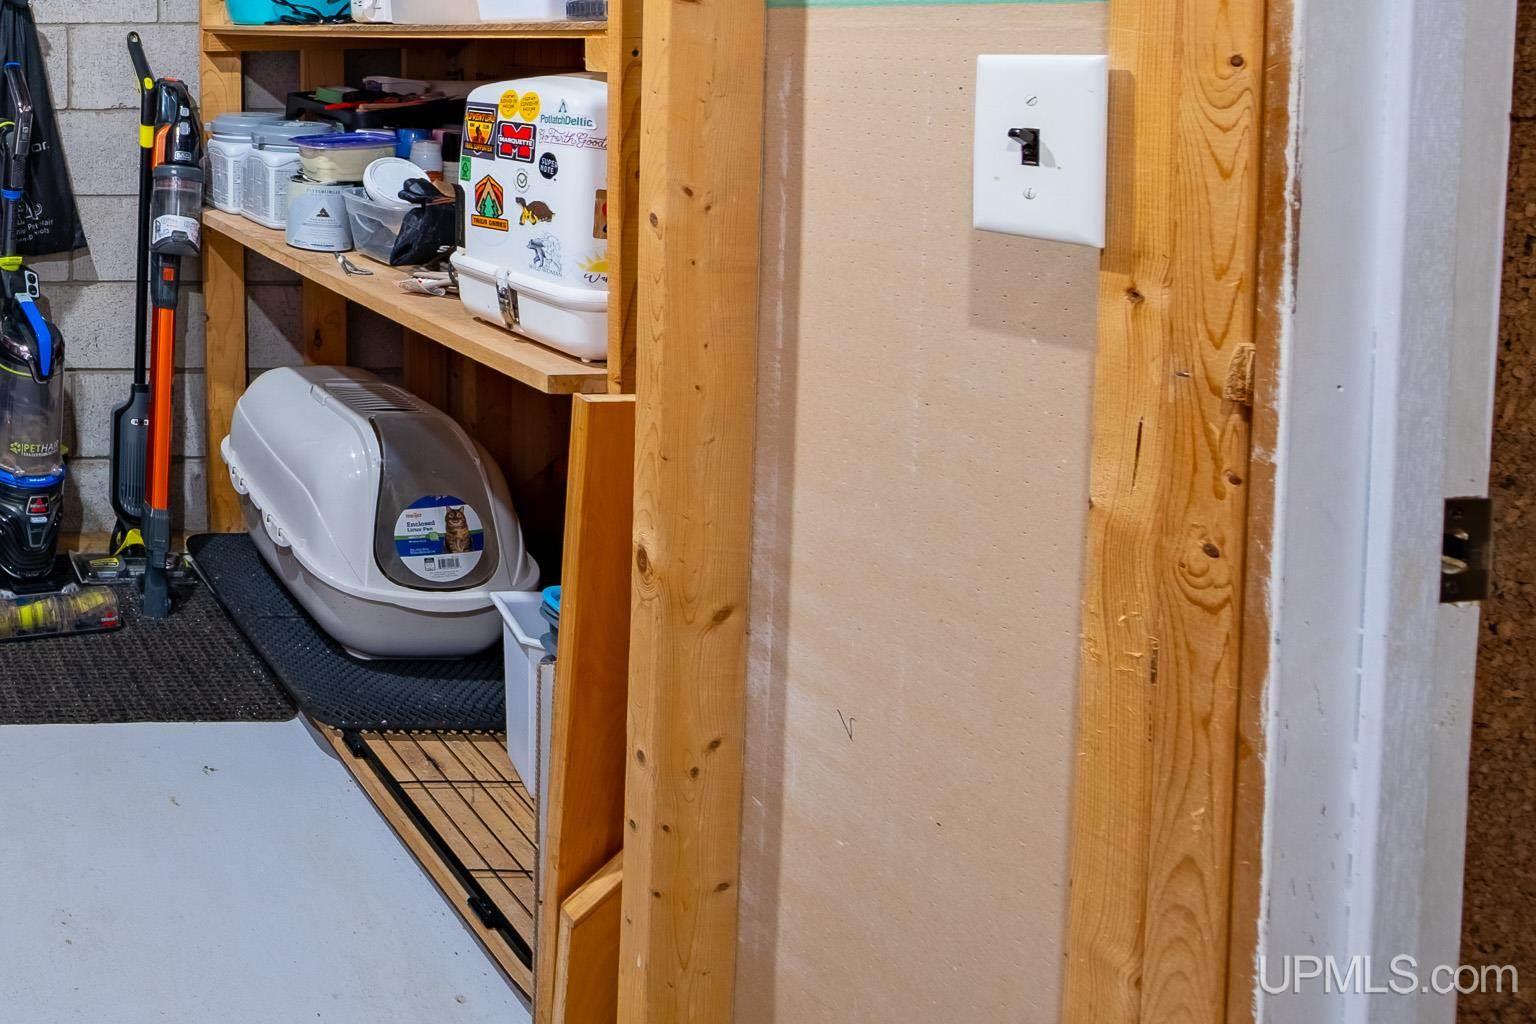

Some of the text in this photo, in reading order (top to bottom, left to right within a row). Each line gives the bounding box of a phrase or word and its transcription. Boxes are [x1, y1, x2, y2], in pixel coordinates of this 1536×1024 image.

[499, 136, 533, 146] MARQUETTE
[541, 157, 558, 168] SUPER
[540, 164, 554, 175] NOTE
